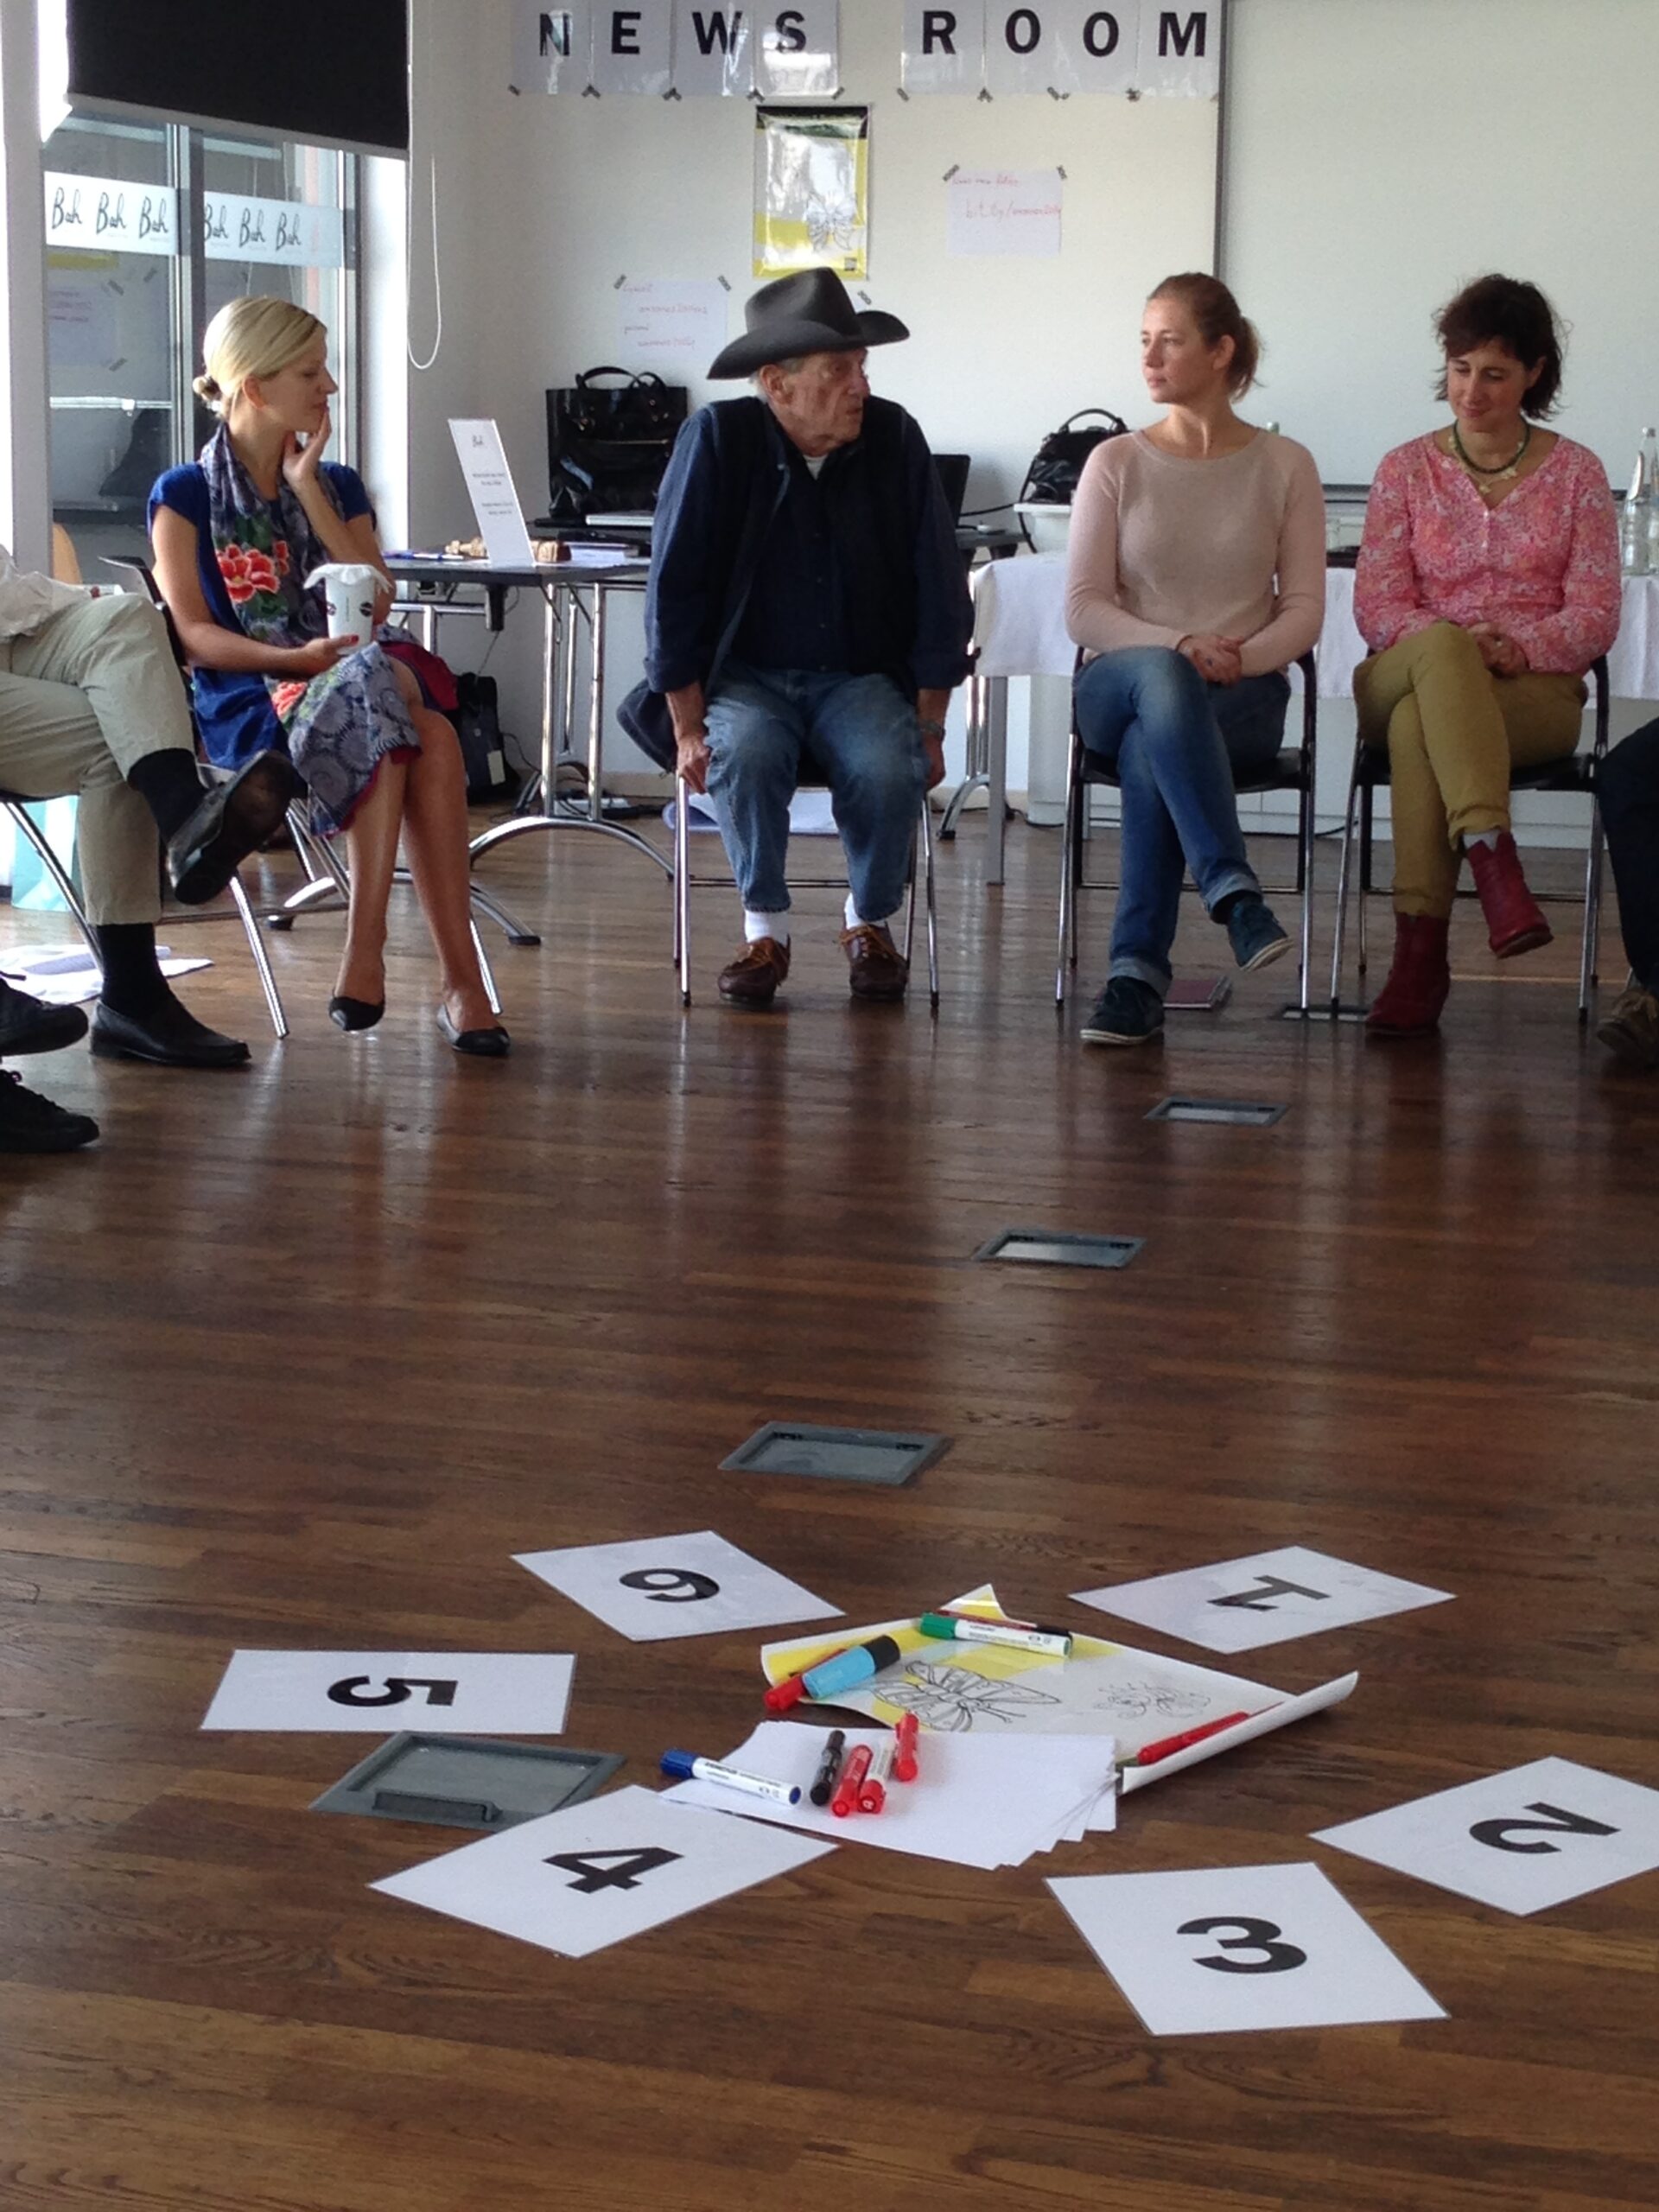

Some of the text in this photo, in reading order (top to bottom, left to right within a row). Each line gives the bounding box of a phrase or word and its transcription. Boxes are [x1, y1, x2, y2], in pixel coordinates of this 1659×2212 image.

[923, 9, 1207, 57] ROOM
[620, 1569, 721, 1603] 6
[1208, 1575, 1330, 1611] 1
[327, 1676, 458, 1707] 5
[1470, 1802, 1619, 1854] 2
[543, 1847, 683, 1894] 4
[1178, 1916, 1307, 1974] 3
